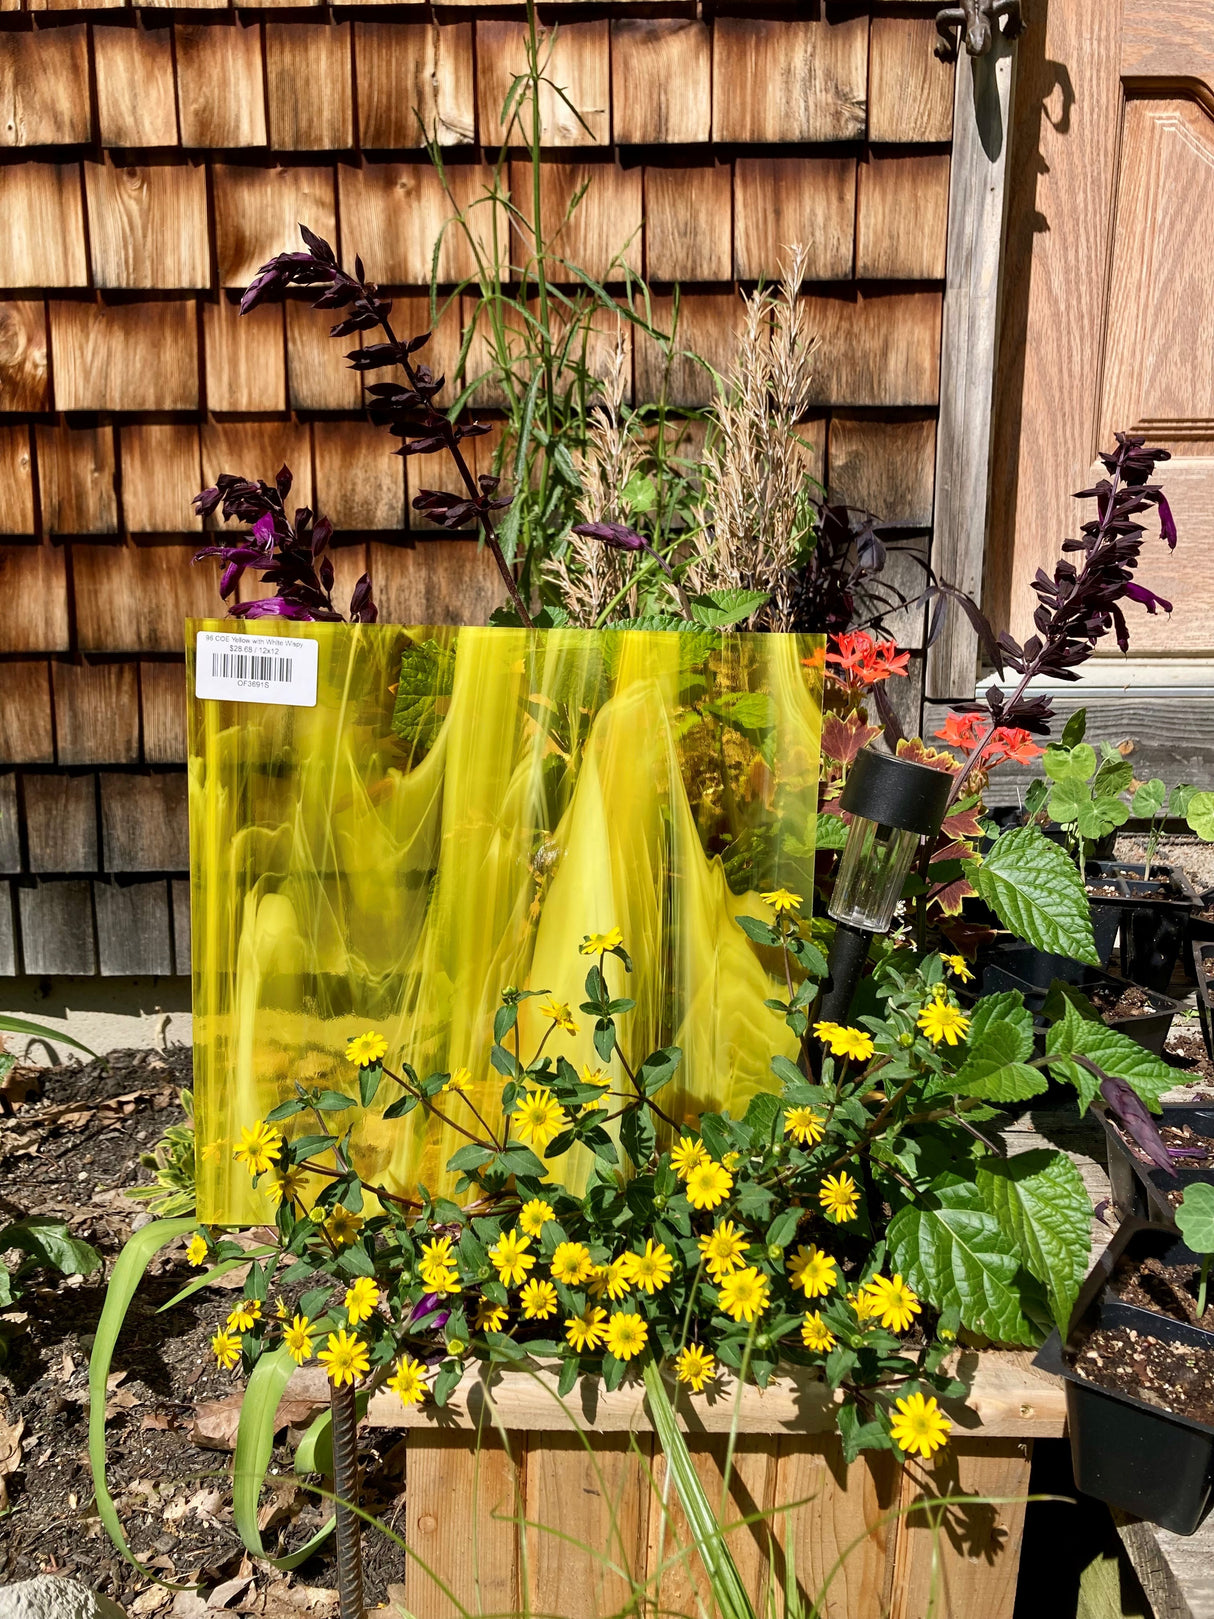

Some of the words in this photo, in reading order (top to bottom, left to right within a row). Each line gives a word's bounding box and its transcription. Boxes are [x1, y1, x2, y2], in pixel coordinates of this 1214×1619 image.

[231, 636, 250, 644] Yellow
[266, 638, 283, 646] White
[259, 647, 279, 655] 12x12
[237, 680, 270, 689] OF3691S
